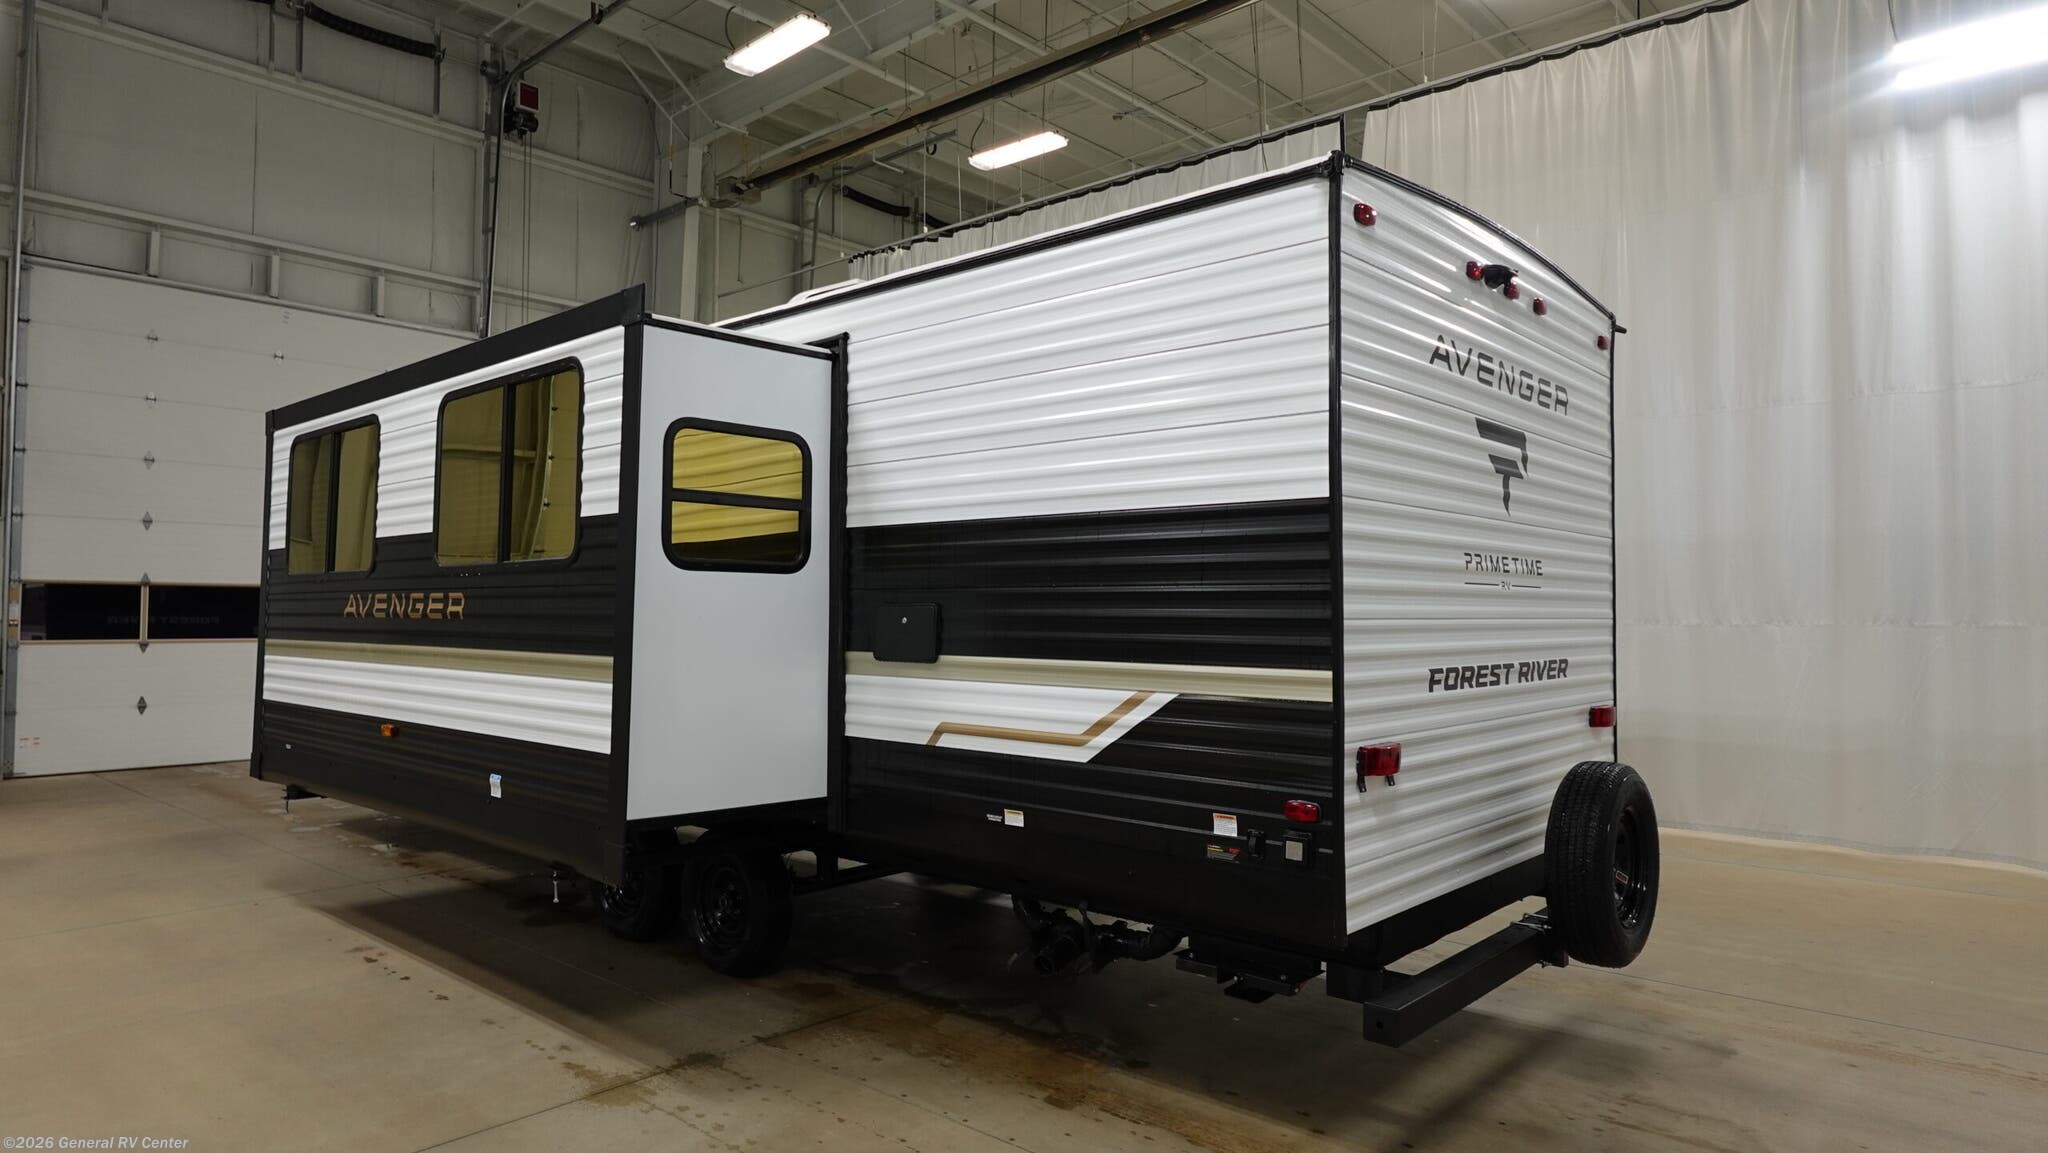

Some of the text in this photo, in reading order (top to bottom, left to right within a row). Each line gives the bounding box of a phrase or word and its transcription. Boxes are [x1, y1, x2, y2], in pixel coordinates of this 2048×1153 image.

[1429, 334, 1569, 416] AVENGER
[1501, 581, 1511, 591] RV
[343, 592, 465, 620] AVENGER
[1428, 658, 1569, 693] FOREST RIVER
